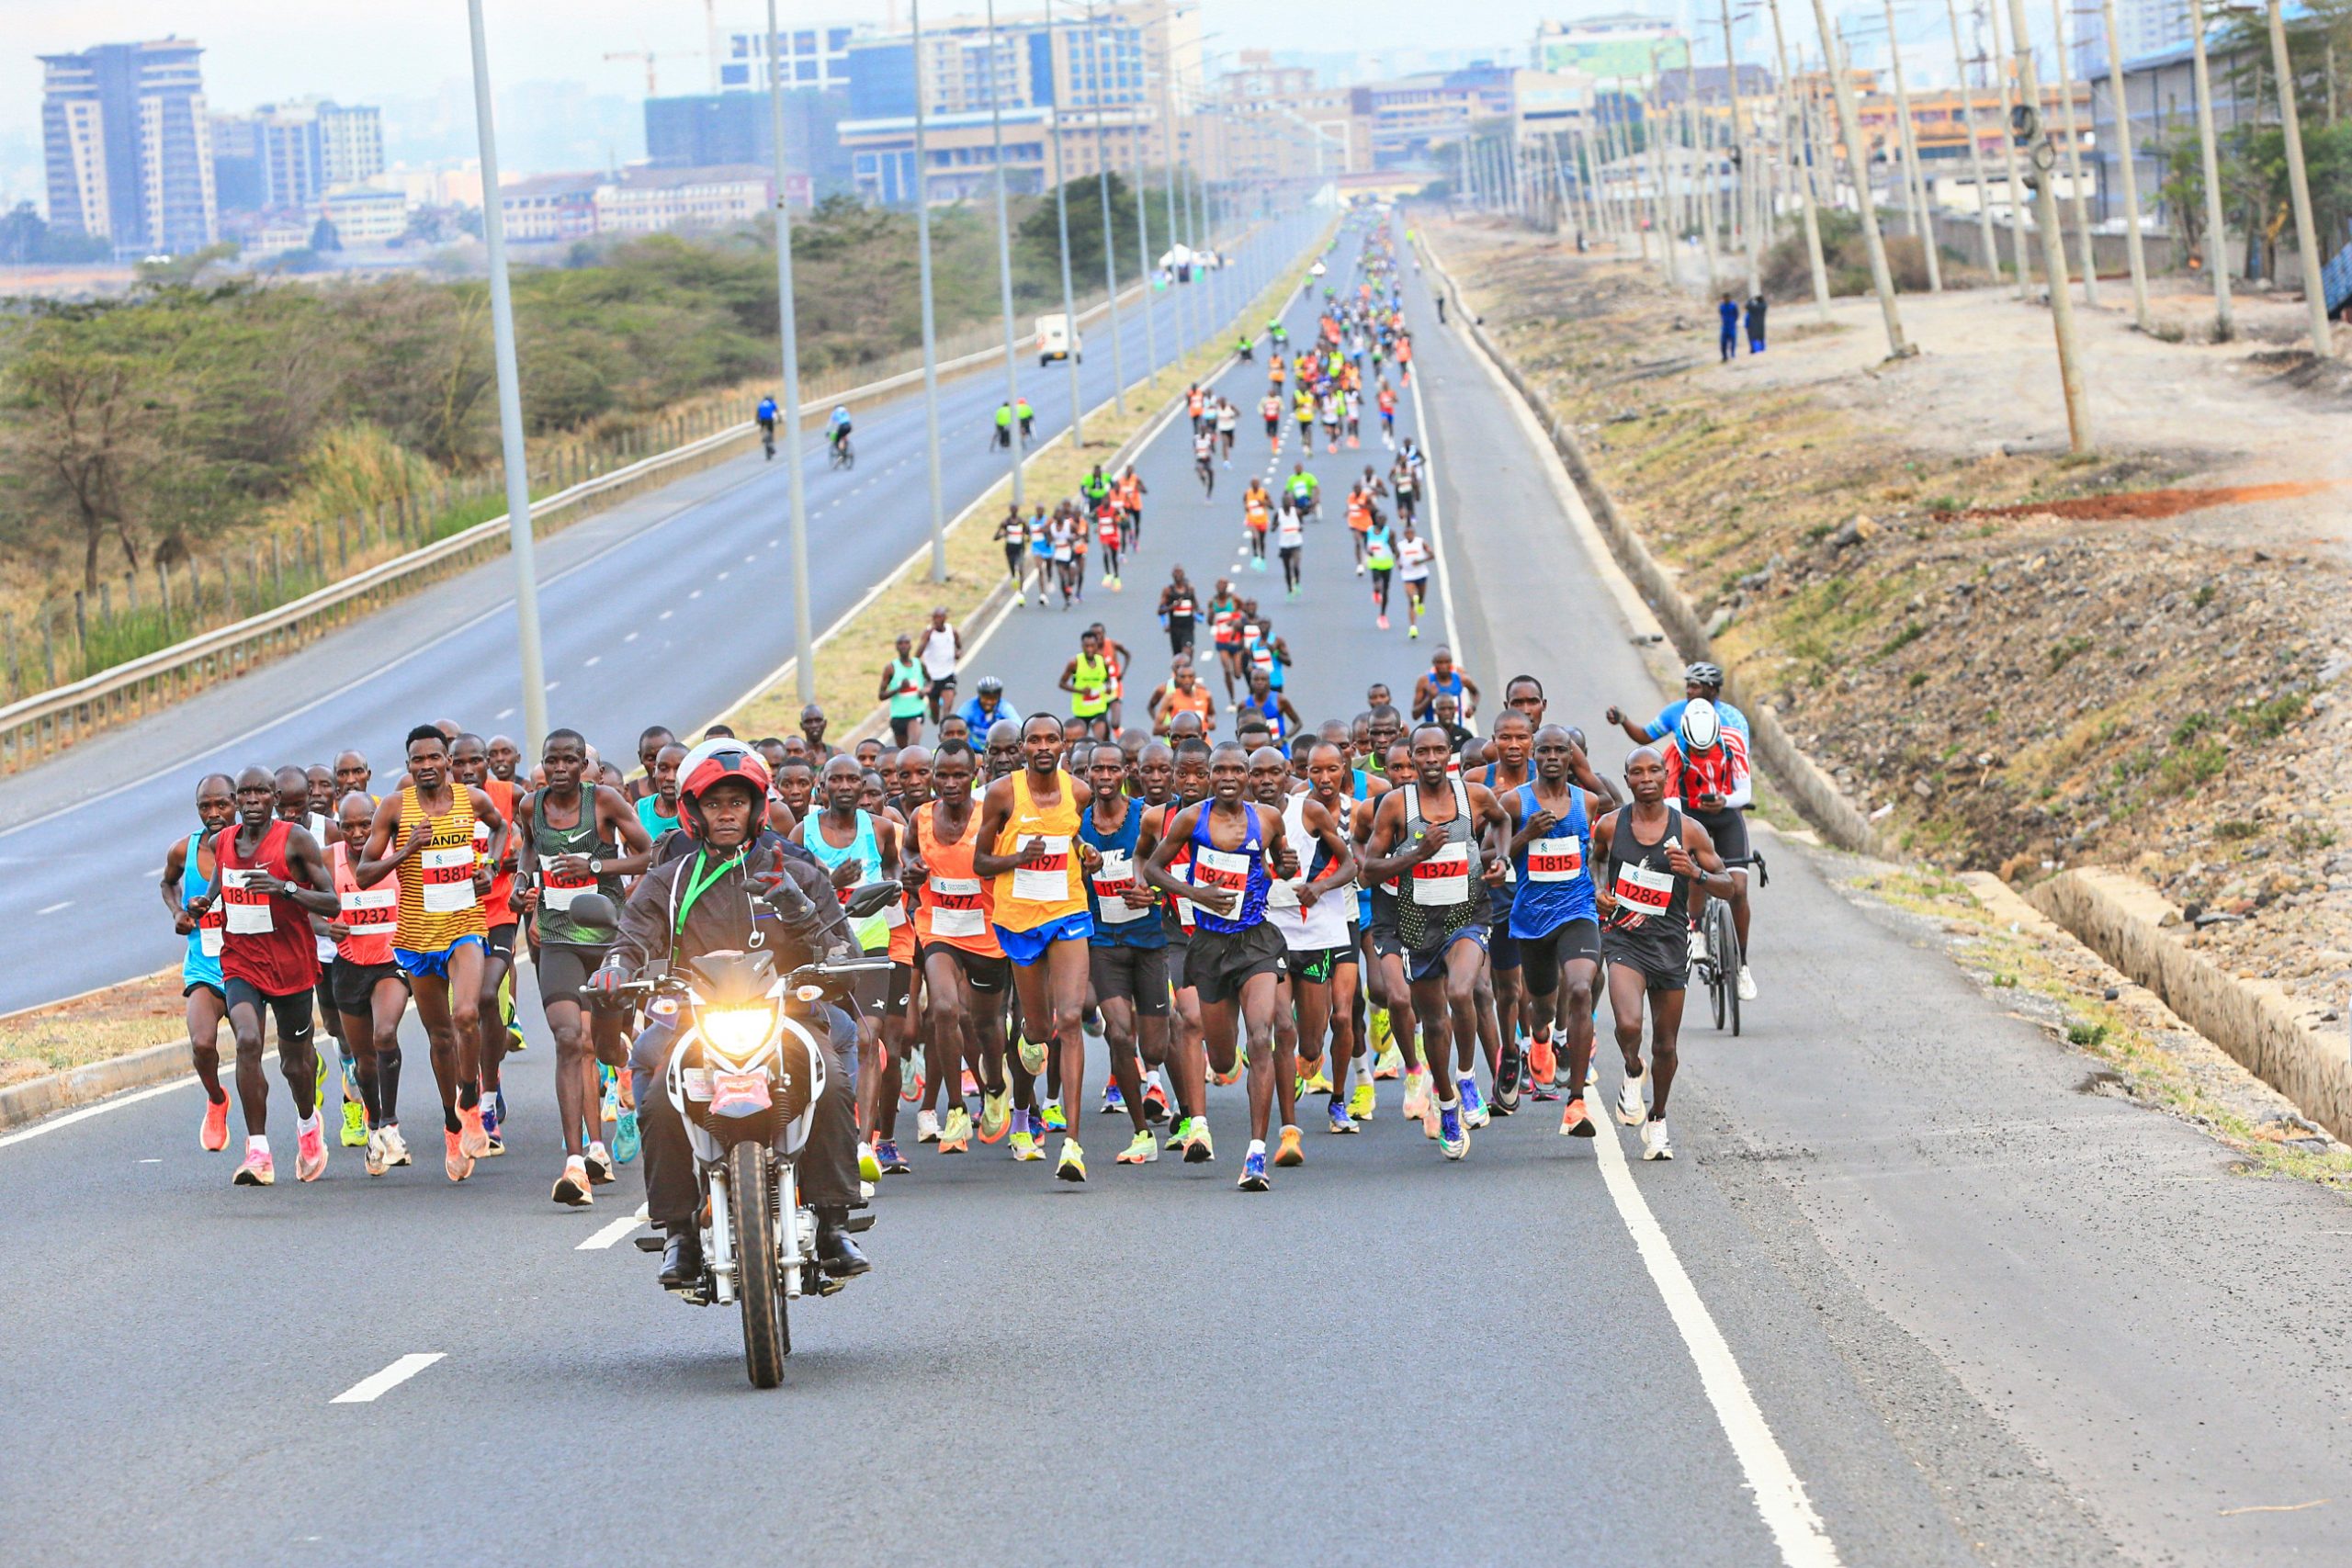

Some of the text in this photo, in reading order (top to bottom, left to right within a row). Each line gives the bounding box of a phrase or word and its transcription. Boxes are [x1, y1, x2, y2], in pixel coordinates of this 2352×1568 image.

[430, 834, 467, 846] ANDA
[472, 838, 489, 853] 36
[1422, 862, 1459, 878] 1327
[1538, 855, 1573, 871] 1815
[433, 866, 467, 883] 1381
[229, 888, 257, 905] 1811
[938, 894, 974, 909] 1477
[1624, 883, 1662, 905] 1286
[206, 912, 222, 928] 13
[351, 908, 390, 925] 1232
